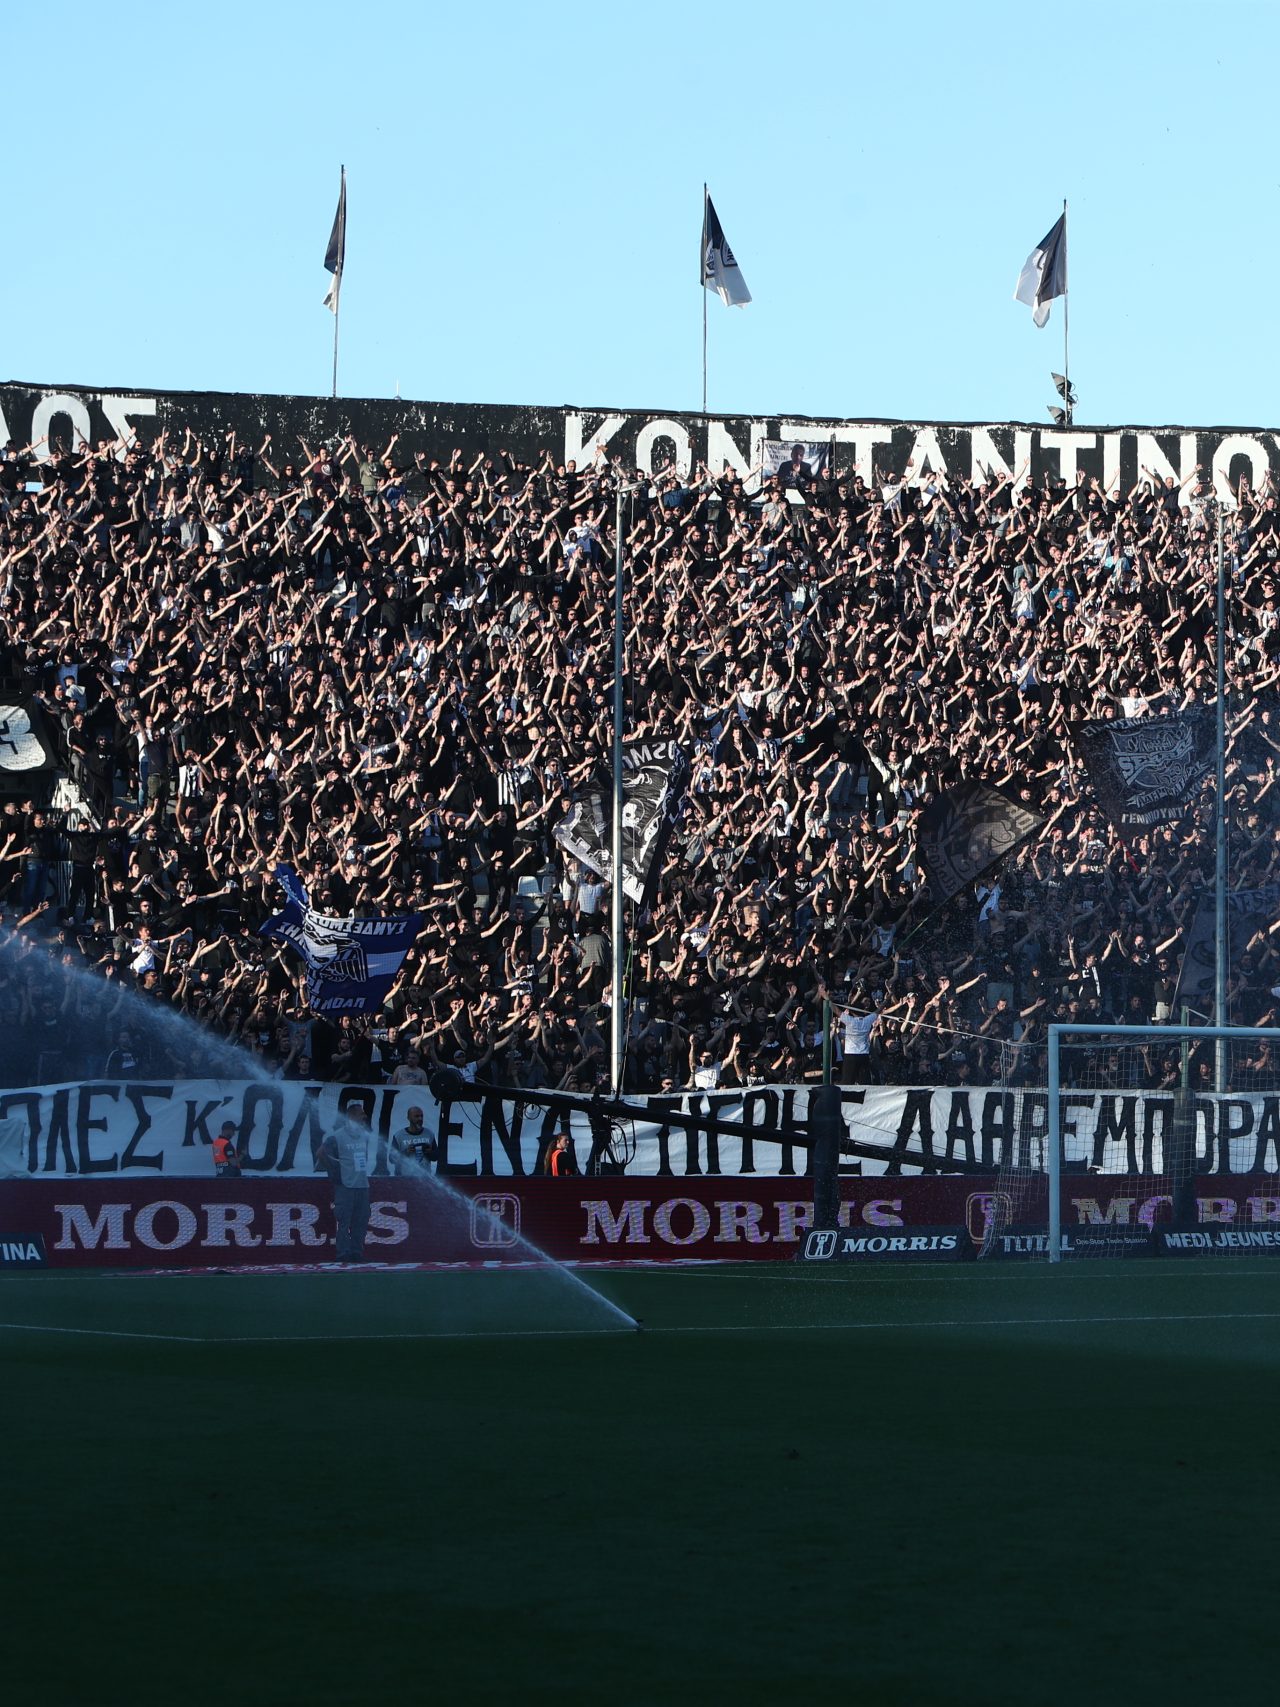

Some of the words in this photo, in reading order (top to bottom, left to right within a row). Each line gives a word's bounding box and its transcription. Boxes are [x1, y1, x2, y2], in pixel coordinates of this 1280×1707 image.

[54, 1200, 409, 1251] MORRS
[841, 1235, 958, 1254] MORRIS
[1163, 1232, 1211, 1249] MEDI
